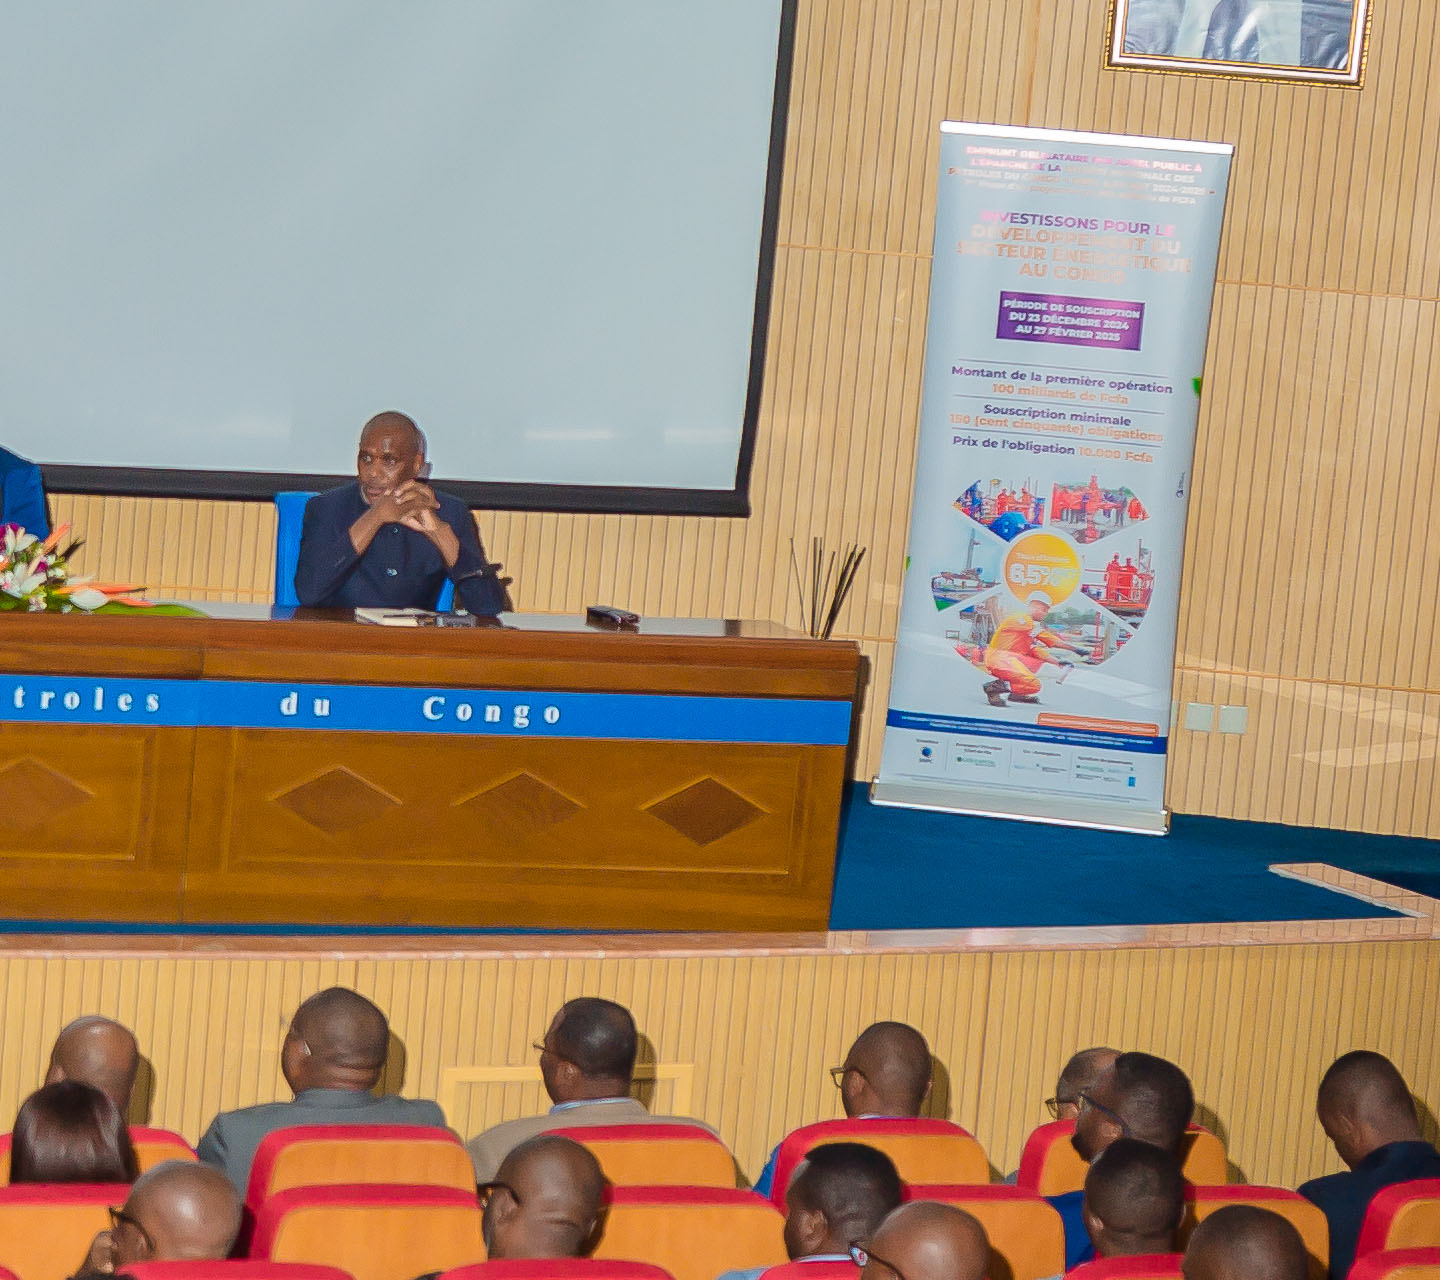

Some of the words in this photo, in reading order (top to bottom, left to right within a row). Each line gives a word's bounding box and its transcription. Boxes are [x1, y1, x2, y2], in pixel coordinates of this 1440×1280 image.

[1153, 160, 1192, 173] PUBLIC
[980, 211, 1099, 231] INVESTISSONS
[1103, 220, 1151, 236] POUR
[1155, 224, 1176, 237] LE
[957, 240, 1048, 260] SECTEUR
[1151, 238, 1182, 255] DU
[1019, 263, 1048, 278] AU
[1053, 266, 1126, 285] CONGO
[1004, 298, 1048, 311] PÉRIODE
[1050, 303, 1064, 312] DE
[1066, 304, 1140, 319] SOUSCRIPTION
[1009, 312, 1026, 321] DU
[1042, 314, 1102, 328] DÉCEMBRE
[1015, 324, 1033, 334] AU
[1049, 326, 1094, 339] FÉVRIER
[951, 365, 1007, 379] Montant
[1010, 369, 1027, 381] de
[1030, 370, 1042, 382] la
[1045, 373, 1105, 389] première
[1108, 378, 1173, 395] opération
[992, 384, 1015, 395] 100
[1017, 384, 1076, 400] milliards
[1079, 390, 1096, 402] de
[983, 403, 1067, 422] Souscription
[1070, 410, 1132, 427] minimale
[1087, 425, 1164, 442] obligations
[952, 435, 979, 448] Prix
[982, 438, 998, 449] de
[1001, 439, 1076, 458] l'obligation
[1124, 450, 1154, 464] Fcfa
[280, 690, 331, 718] du
[422, 694, 561, 729] Congo
